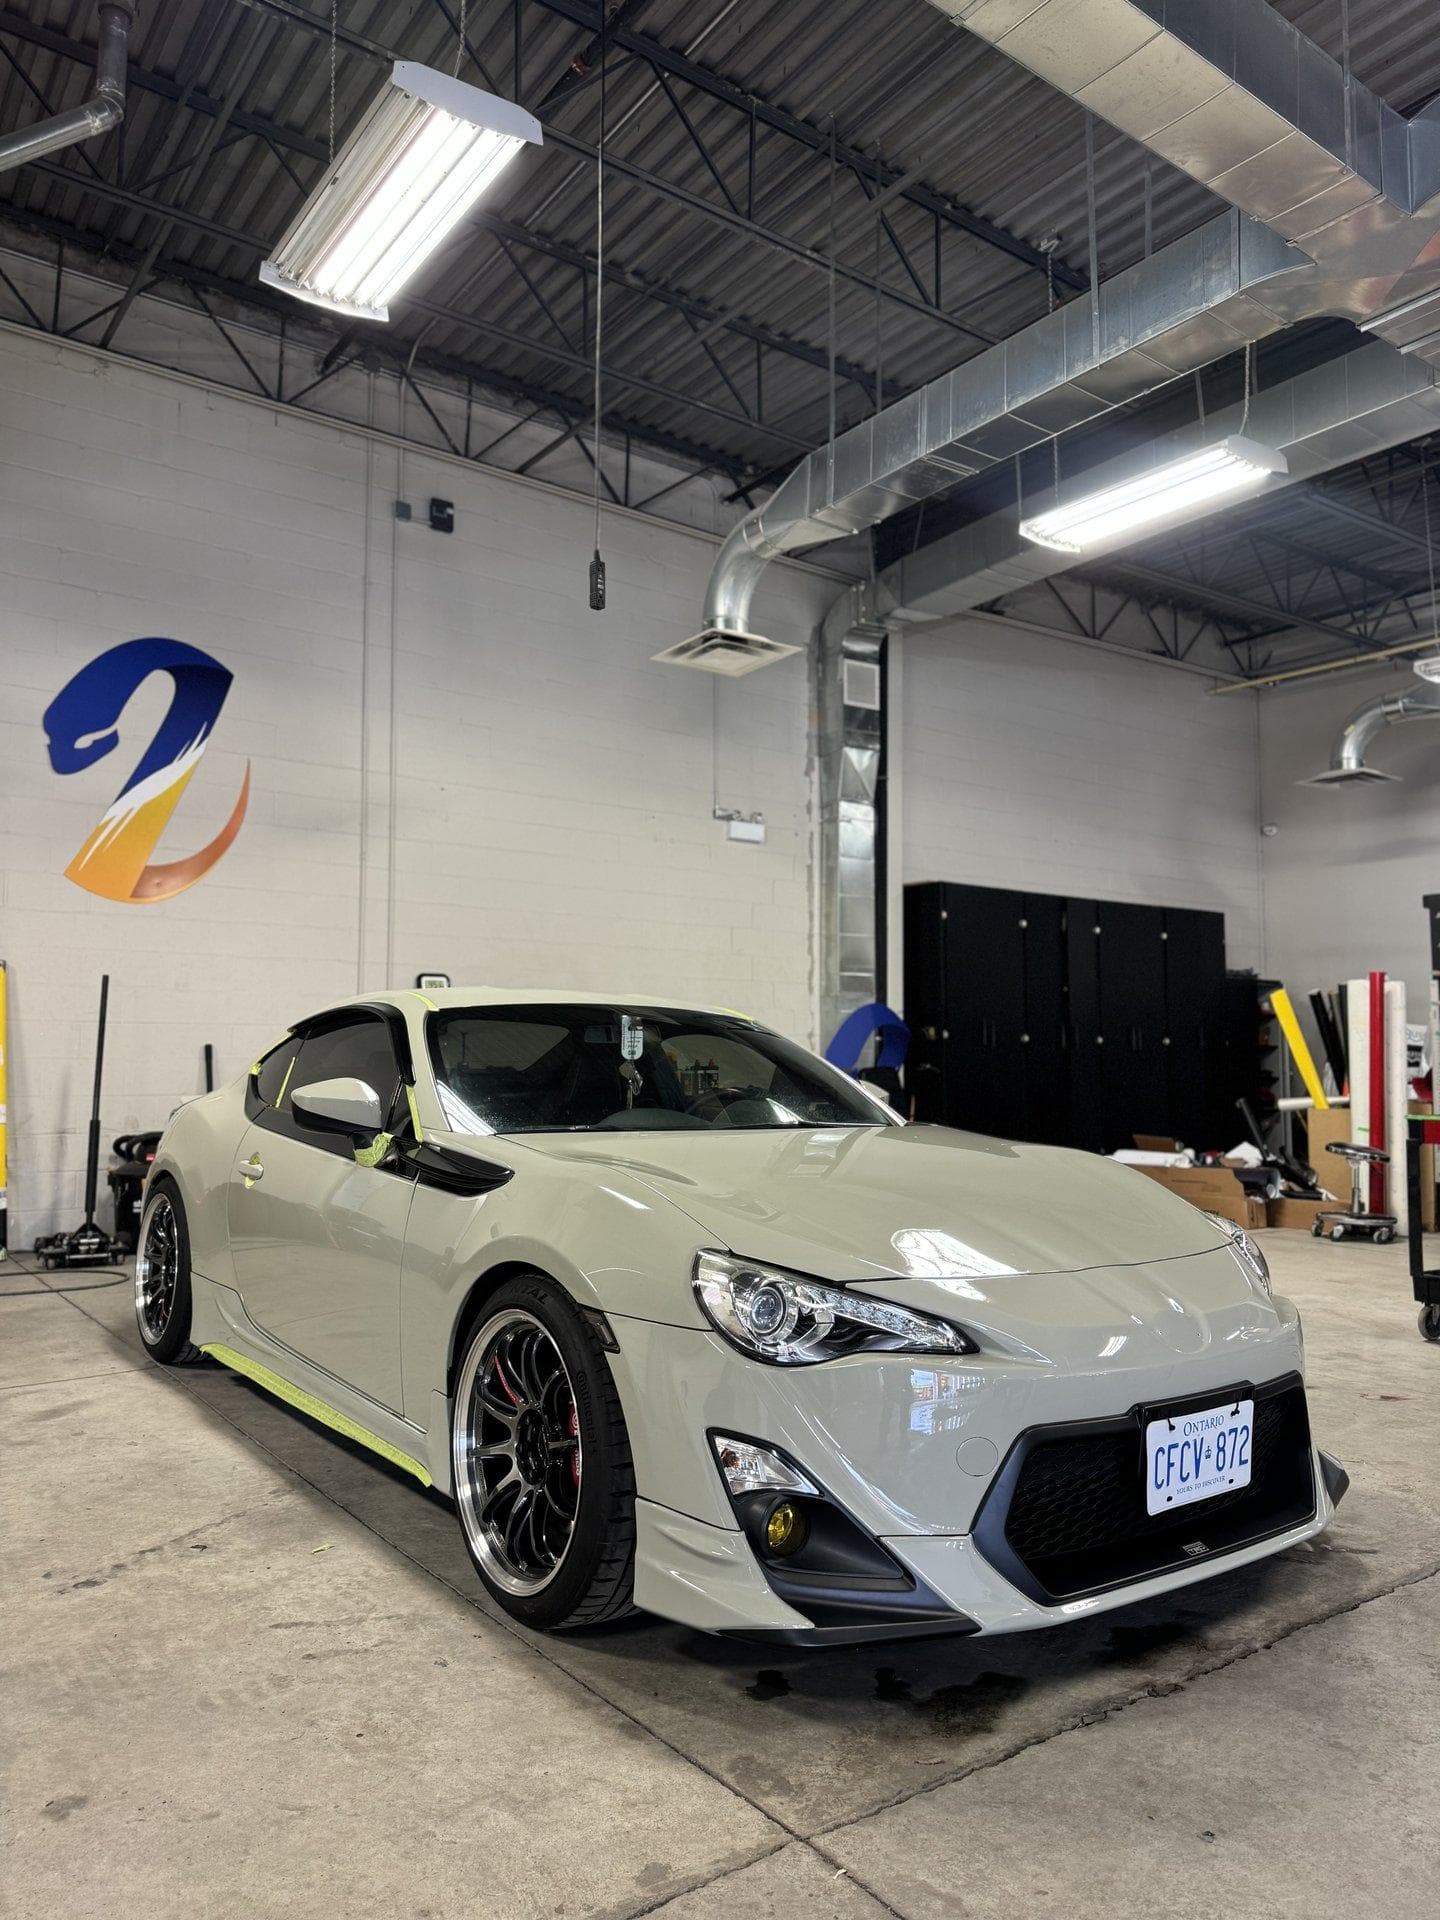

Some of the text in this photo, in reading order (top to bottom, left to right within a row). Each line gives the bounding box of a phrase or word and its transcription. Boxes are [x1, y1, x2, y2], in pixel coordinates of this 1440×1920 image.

[1183, 1415, 1224, 1437] ONTARIO
[1154, 1425, 1250, 1490] CFCV 872
